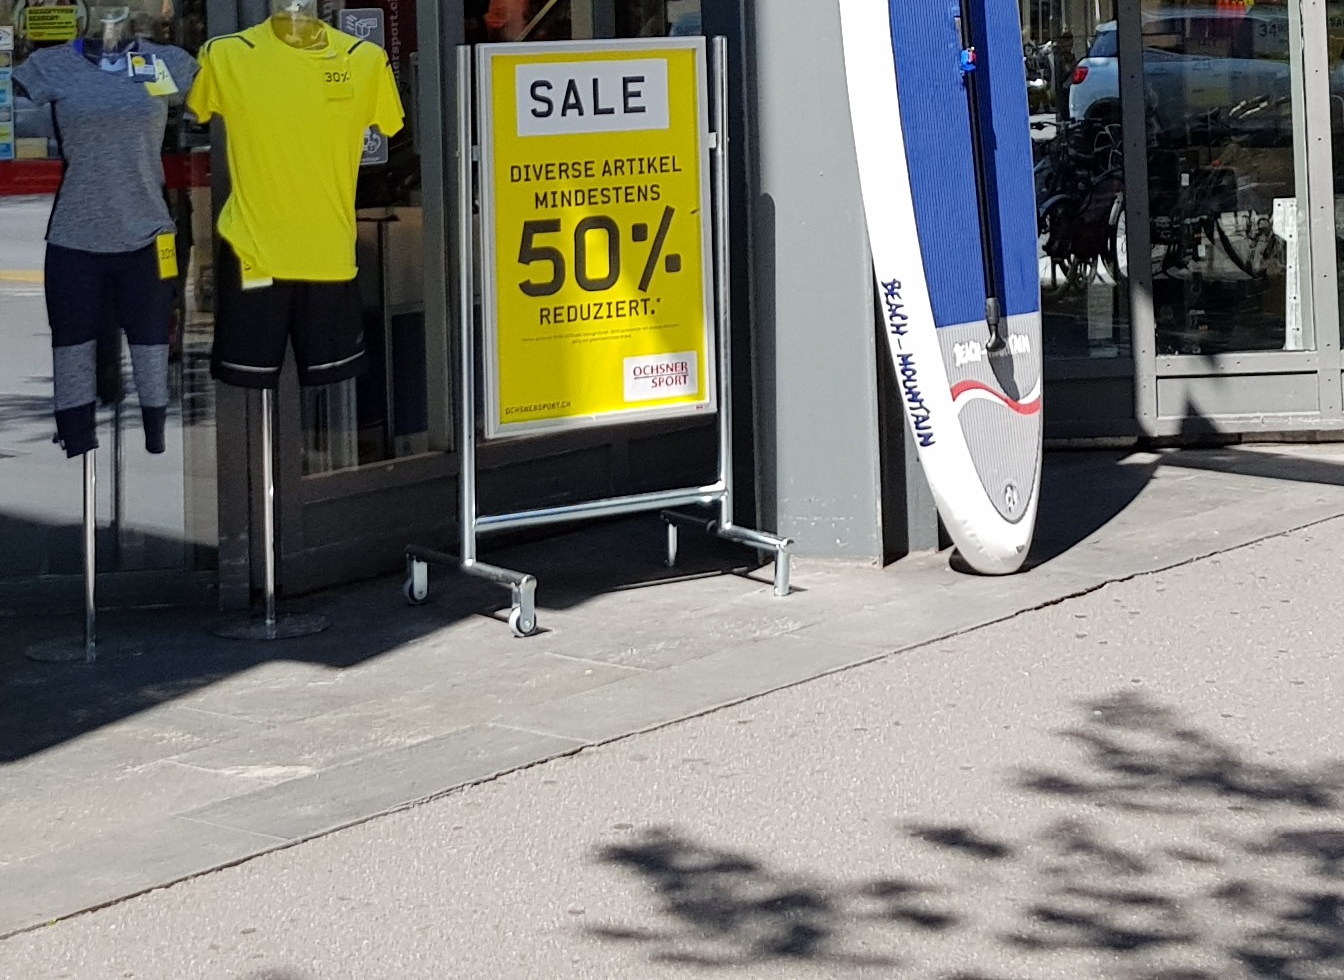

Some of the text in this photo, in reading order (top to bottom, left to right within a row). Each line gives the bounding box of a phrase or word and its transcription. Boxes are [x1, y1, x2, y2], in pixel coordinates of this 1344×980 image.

[324, 71, 350, 83] 30%
[529, 75, 647, 118] SALE
[510, 155, 682, 183] DIVERSE ARTIKEL
[534, 184, 661, 209] MINDESTENS
[518, 205, 681, 297] 50%
[632, 361, 689, 378] OCHSNER
[651, 374, 689, 389] SPORT
